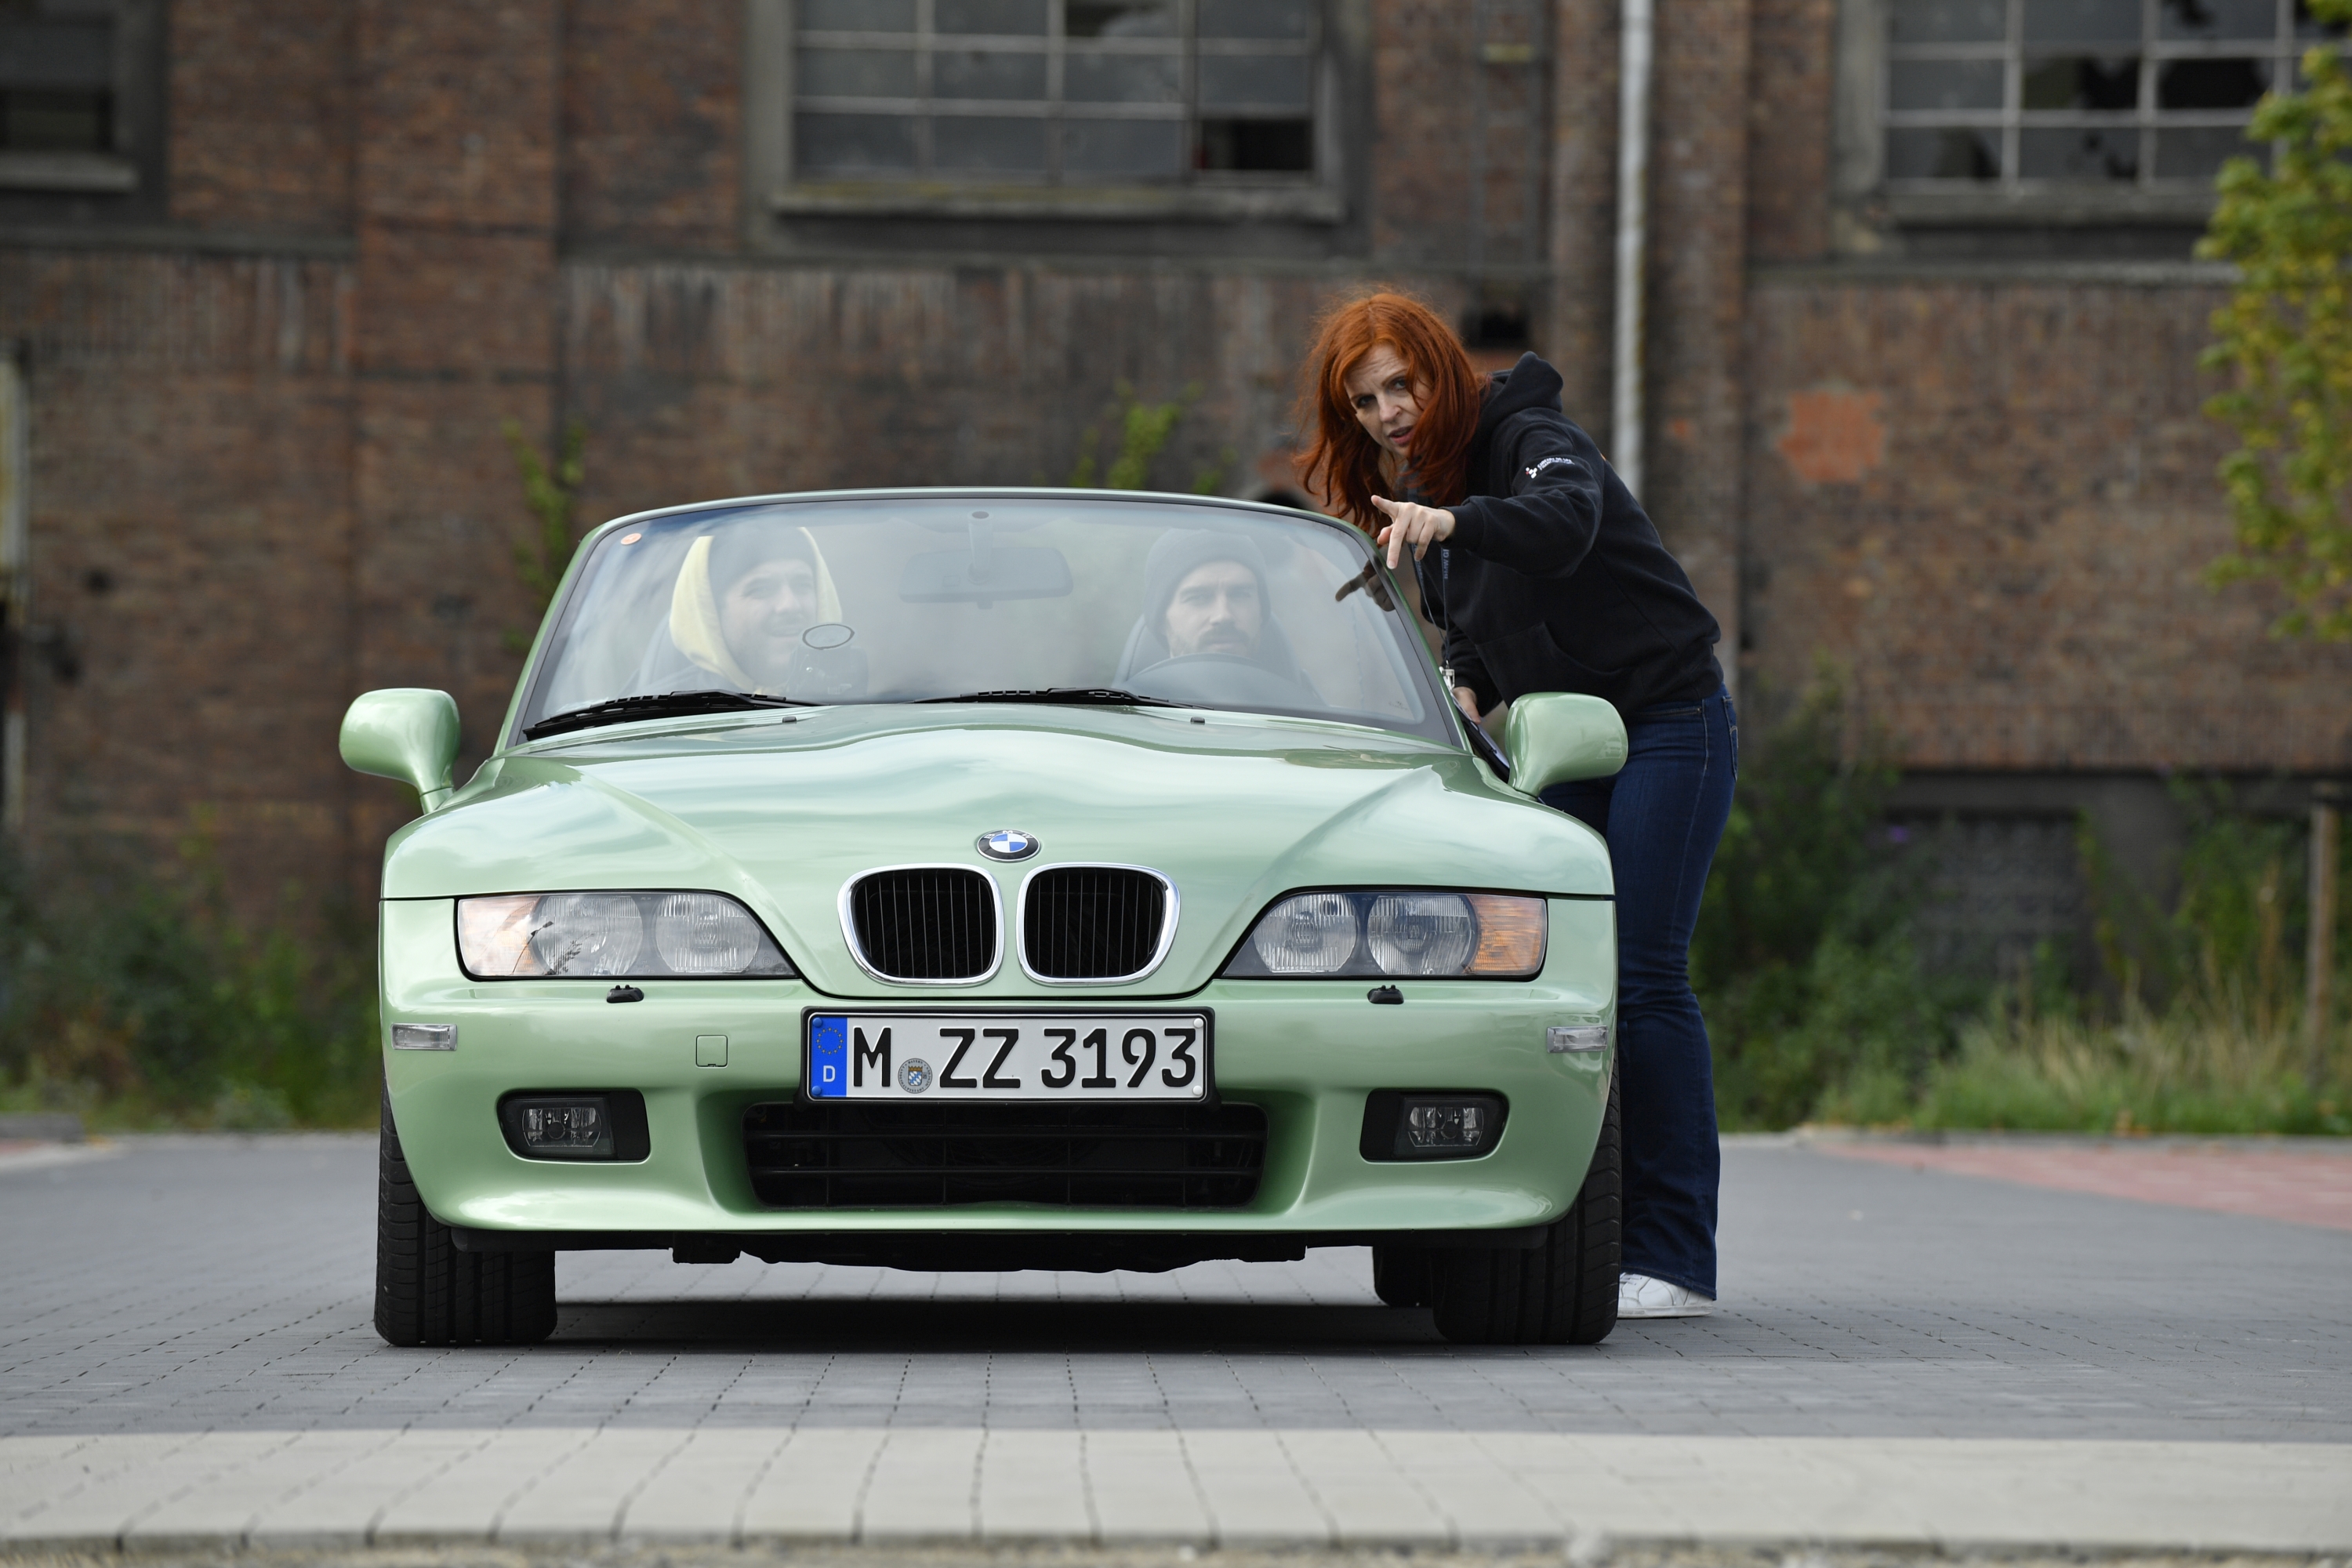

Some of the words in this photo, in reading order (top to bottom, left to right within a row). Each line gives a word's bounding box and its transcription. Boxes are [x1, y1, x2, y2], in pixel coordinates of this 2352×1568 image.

[984, 830, 1033, 839] BMW
[853, 1027, 891, 1087] M
[939, 1029, 1021, 1088] ZZ
[1041, 1029, 1196, 1088] 3193
[822, 1065, 836, 1082] D
